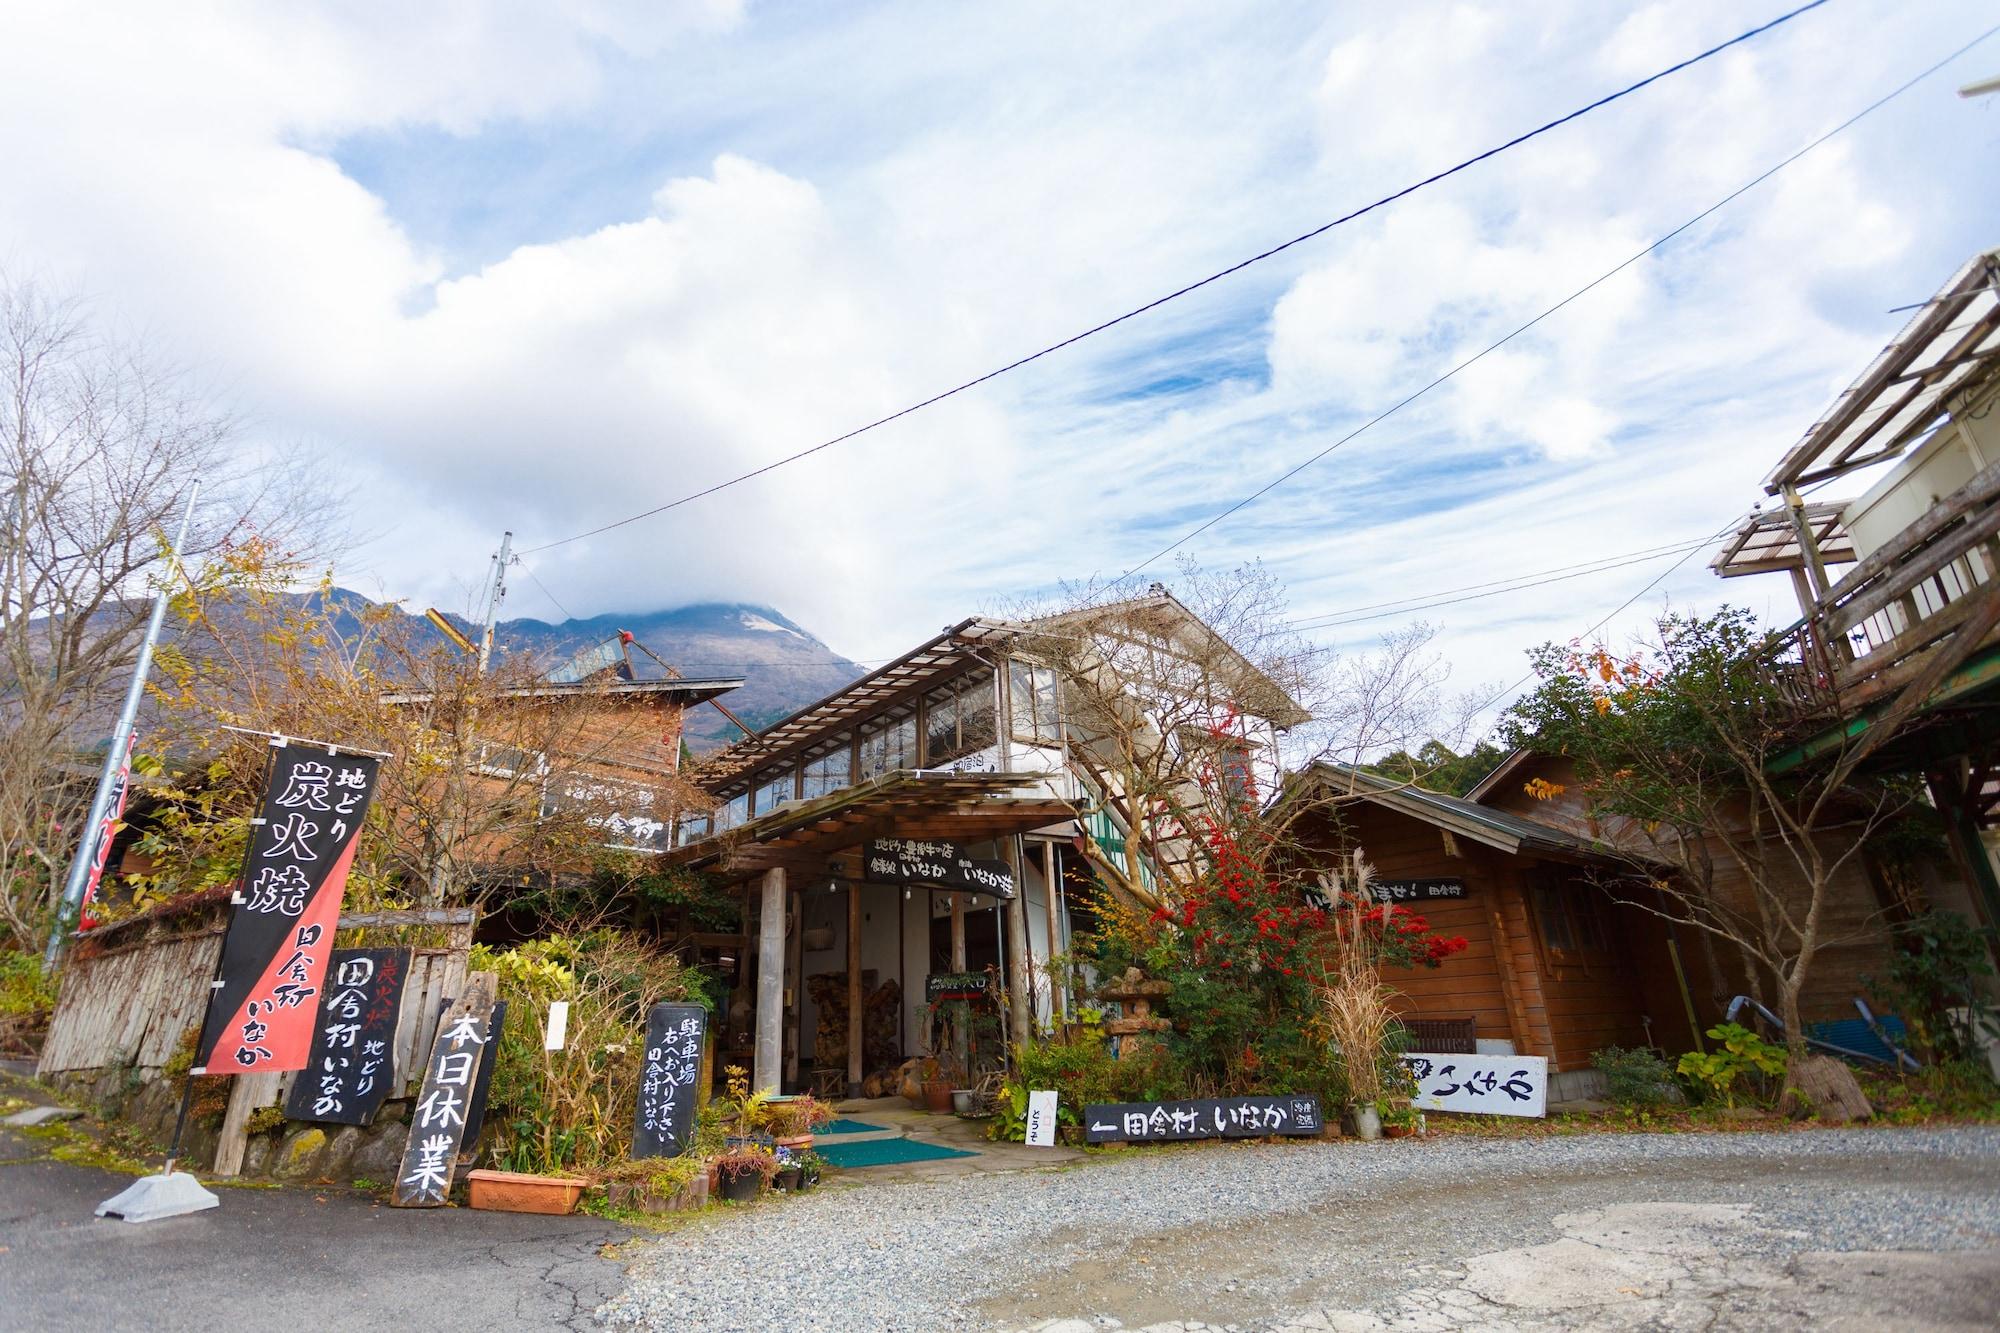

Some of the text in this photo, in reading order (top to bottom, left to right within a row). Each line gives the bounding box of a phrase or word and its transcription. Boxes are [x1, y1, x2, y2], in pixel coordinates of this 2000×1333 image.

[247, 761, 333, 917] 炭火焼
[329, 767, 367, 843] 地どり
[902, 862, 947, 877] いなか
[964, 868, 1014, 894] いなか荘
[273, 923, 322, 1008] 田舎村
[235, 1000, 274, 1065] いなか
[356, 1040, 385, 1096] 地どり
[677, 1018, 700, 1085] 駐車場
[403, 1013, 485, 1190] 本日休業
[658, 1026, 680, 1142] 右へお入り下さい
